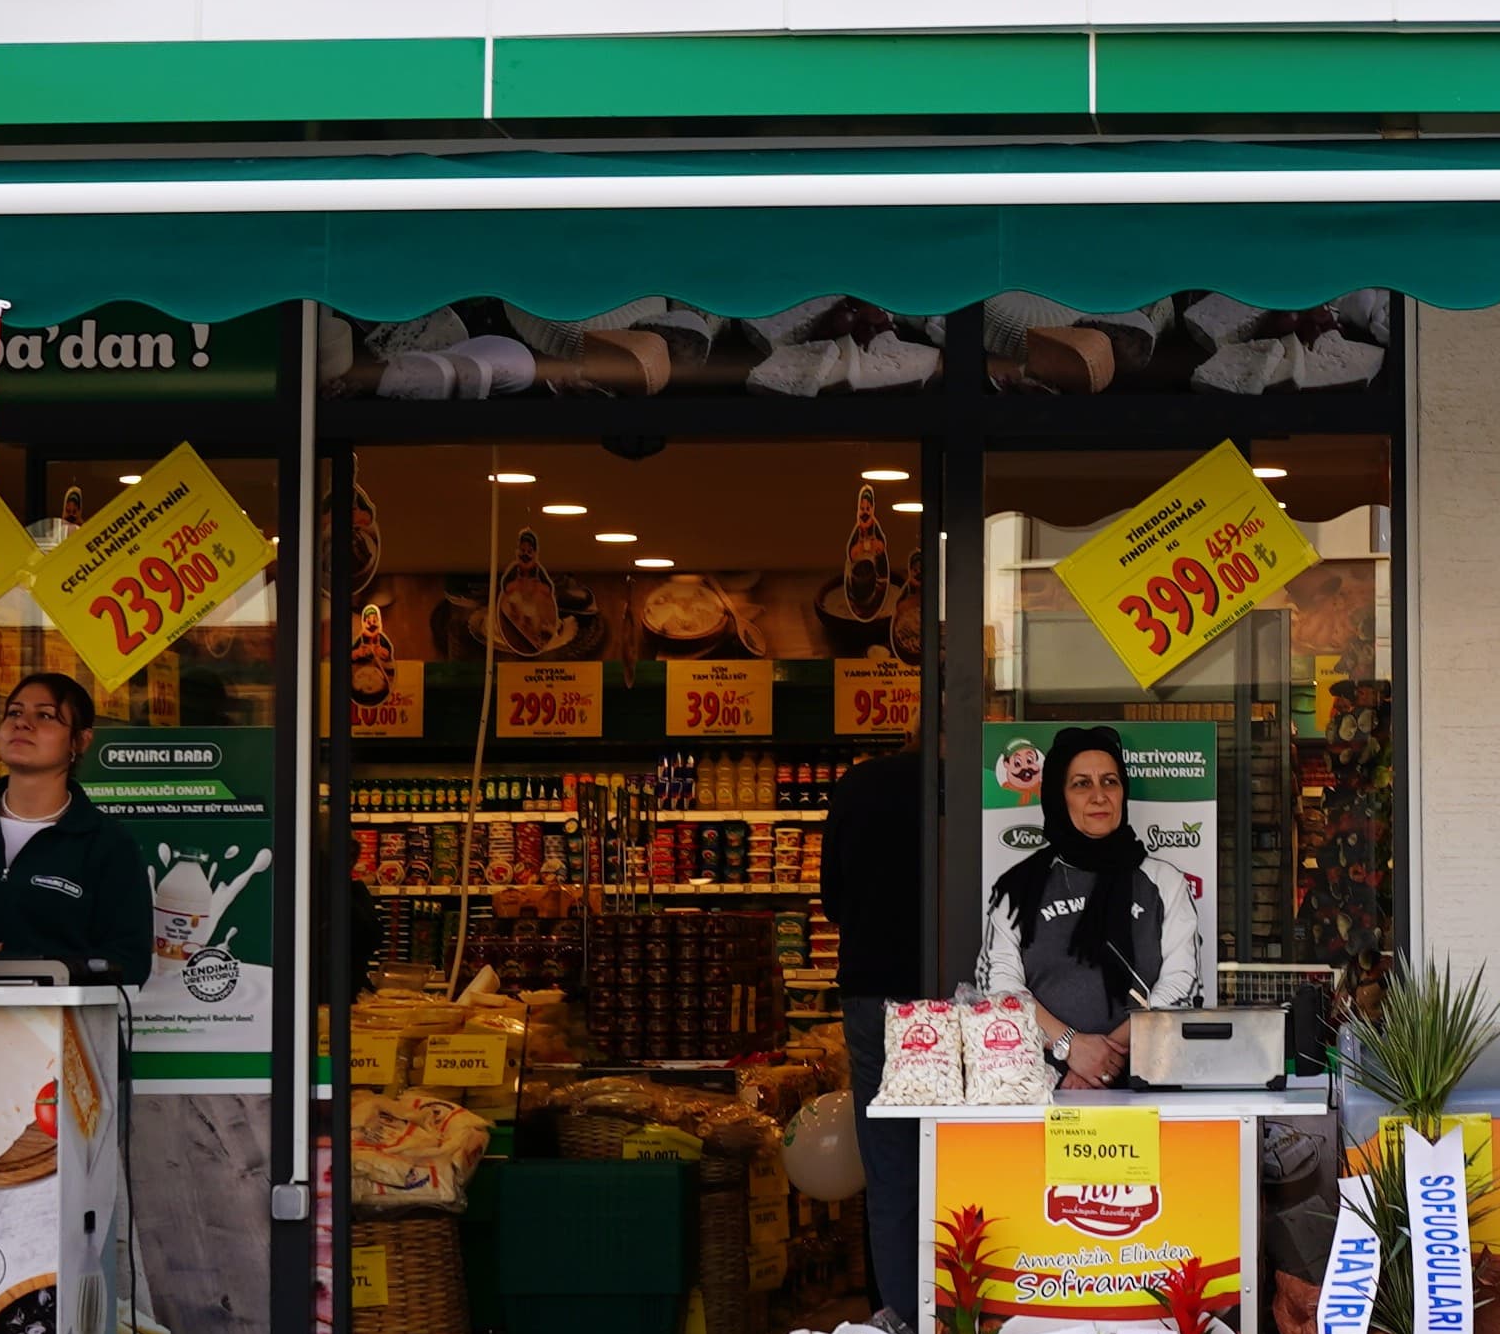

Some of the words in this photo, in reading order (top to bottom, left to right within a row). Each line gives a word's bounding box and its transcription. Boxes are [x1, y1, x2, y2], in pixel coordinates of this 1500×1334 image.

[85, 501, 147, 555] ERZURUM
[104, 522, 142, 560] MİNZİ
[140, 481, 190, 530] PEYNİRİ
[1119, 534, 1160, 568] FINDIK
[1157, 498, 1208, 540] KIRMASI
[1125, 498, 1184, 544] TİREBOLU
[1166, 539, 1181, 553] KG
[173, 748, 213, 763] BABA
[115, 784, 176, 797] BAKANLIĞI
[176, 784, 217, 796] ONAYLI
[1011, 829, 1043, 845] Yöre
[1149, 824, 1201, 851] Sosero
[1041, 896, 1087, 922] NEW
[1063, 1144, 1140, 1160] 159,00TL
[1014, 1245, 1113, 1270] Annenizin
[1120, 1240, 1193, 1264] Elinden
[1420, 1174, 1468, 1332] SOFUOĞULLARI
